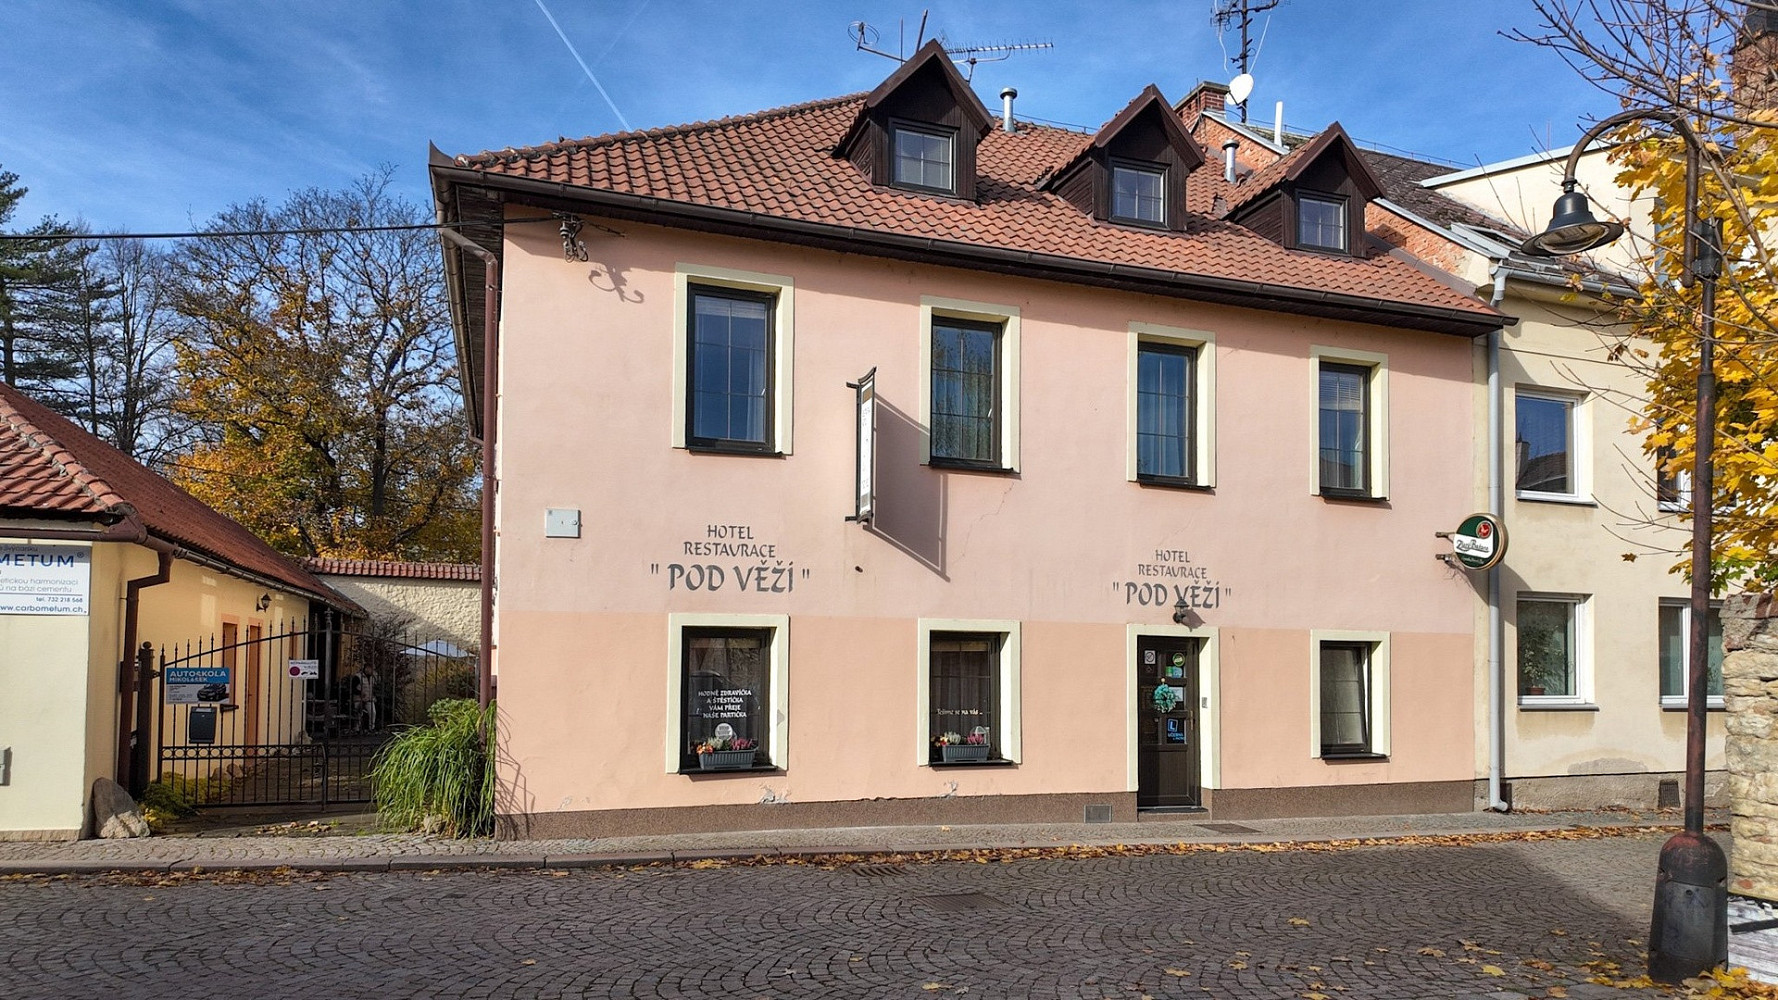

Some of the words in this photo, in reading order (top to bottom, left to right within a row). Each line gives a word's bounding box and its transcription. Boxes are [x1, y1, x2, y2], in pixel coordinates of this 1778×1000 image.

[707, 524, 754, 540] HOTEL
[683, 541, 776, 558] RESTAURACE
[1155, 549, 1190, 563] HOTEL
[732, 559, 794, 593] VĚŽÍ
[1138, 563, 1207, 579] RESTAURACE
[0, 604, 83, 613] ww.carbometum.ch
